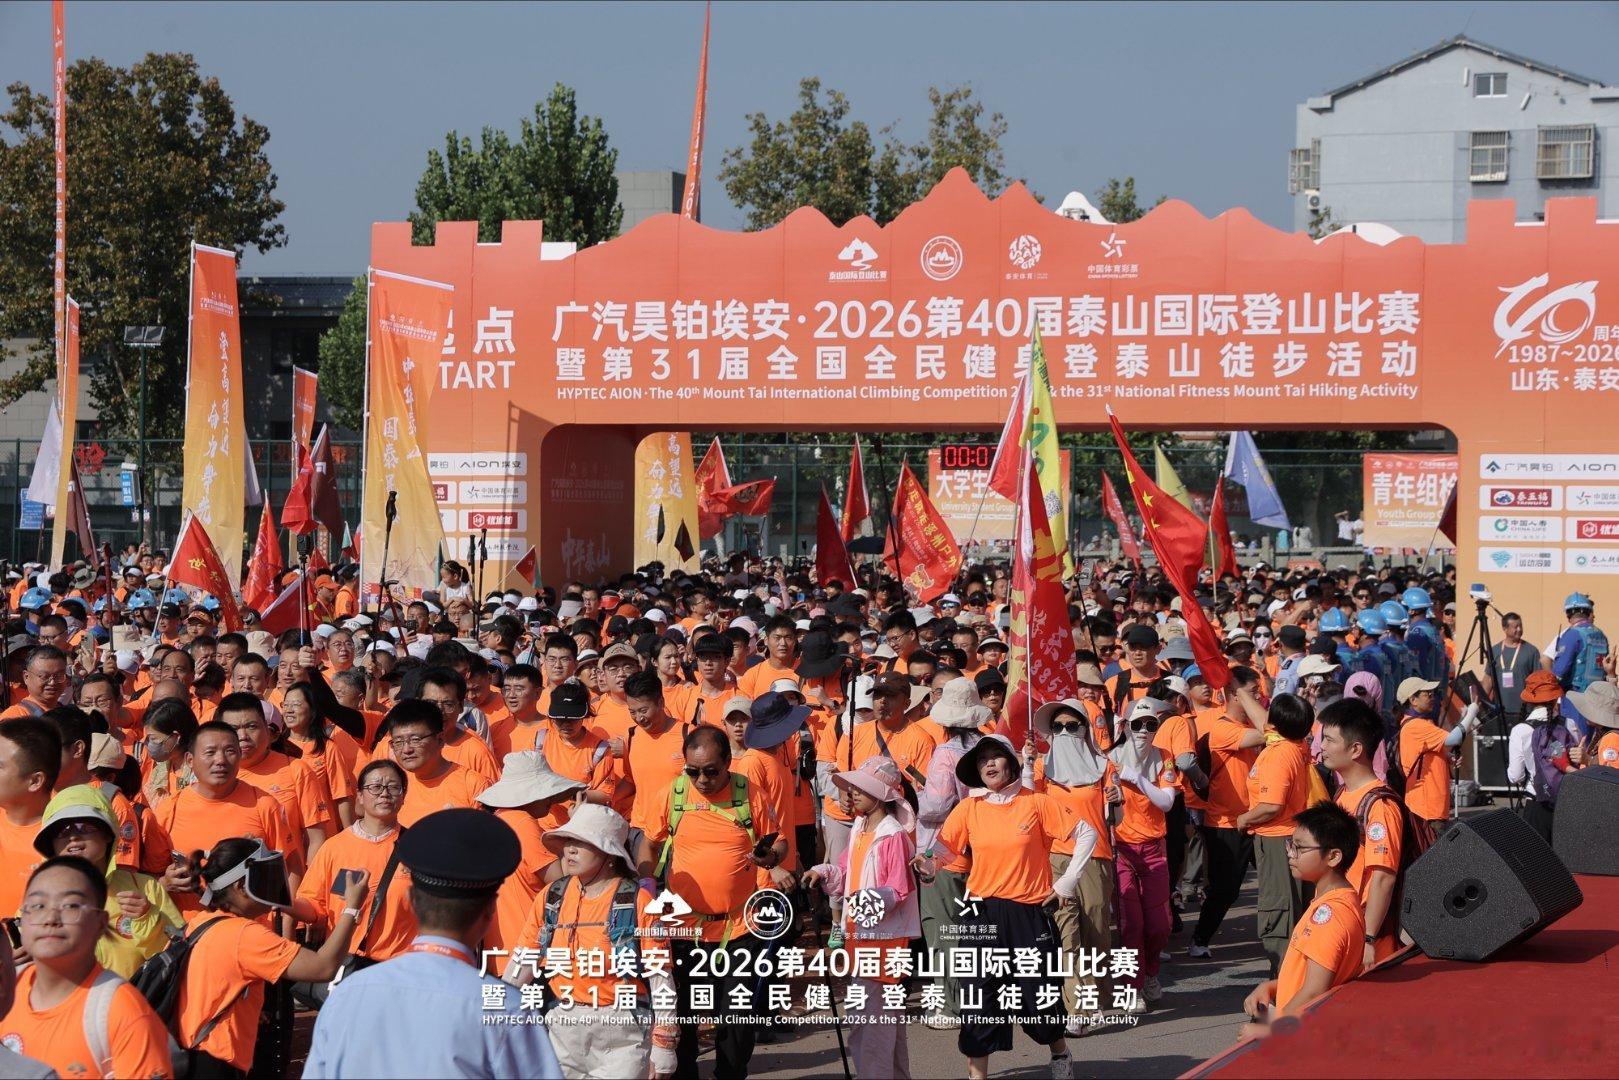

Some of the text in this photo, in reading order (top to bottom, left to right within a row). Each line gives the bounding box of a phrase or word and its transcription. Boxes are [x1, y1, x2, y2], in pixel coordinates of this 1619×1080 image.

[1087, 264, 1138, 273] 中国体育彩票
[439, 360, 516, 389] TART
[557, 387, 607, 400] HYPTEC
[676, 386, 700, 399] 40th
[703, 387, 745, 399] Mount
[748, 386, 767, 399] Tai
[770, 385, 857, 399] International
[859, 385, 921, 402] Climbing
[923, 384, 1007, 401] Competition
[1060, 384, 1084, 398] the
[1087, 384, 1111, 397] 31st
[1114, 384, 1175, 398] National
[1178, 383, 1230, 397] Fitness
[1233, 384, 1281, 397] Mount
[1284, 384, 1305, 397] Tai
[1309, 383, 1357, 401] Hiking
[1361, 382, 1418, 400] Activity
[668, 432, 683, 499] 高望远
[945, 446, 997, 467] 00:0
